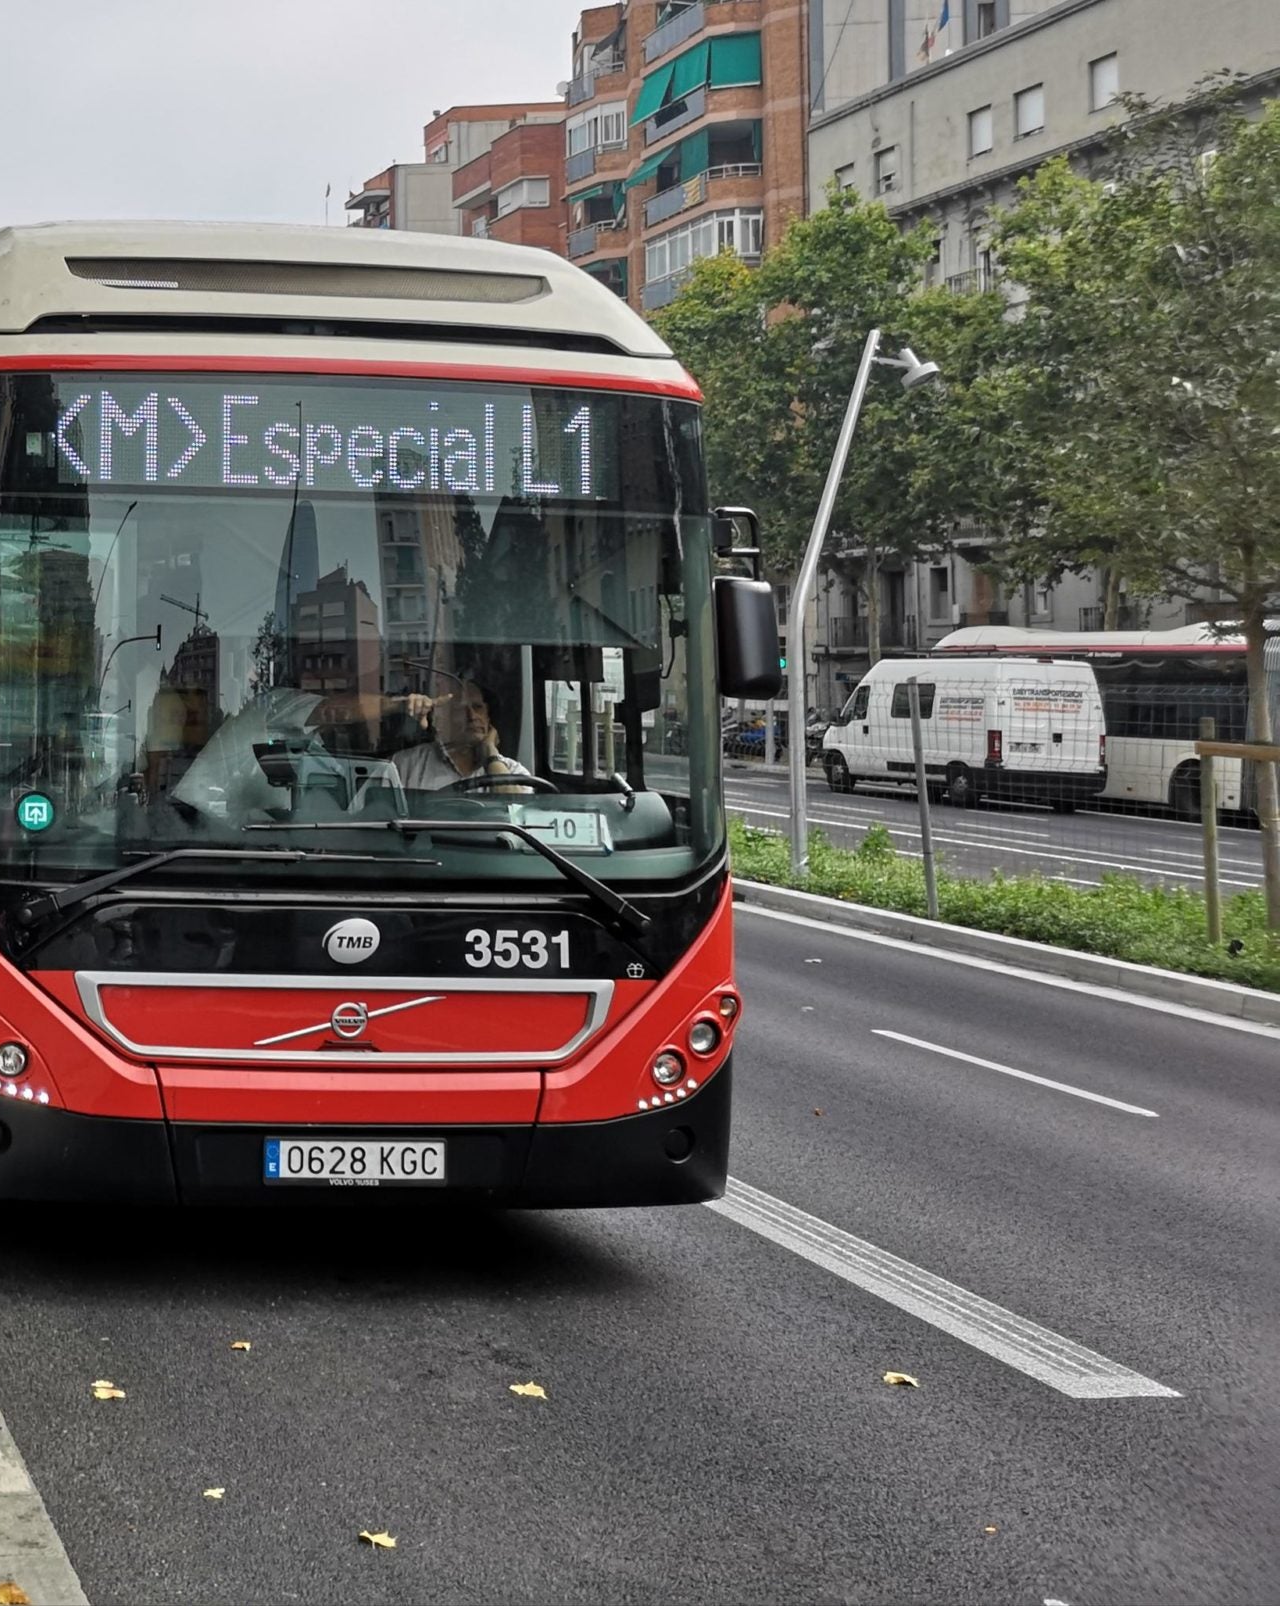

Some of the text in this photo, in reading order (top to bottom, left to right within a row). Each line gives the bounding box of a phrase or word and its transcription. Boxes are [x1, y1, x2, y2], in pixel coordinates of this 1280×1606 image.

[222, 395, 495, 492] Especial
[523, 404, 592, 495] L1
[550, 818, 577, 839] 10
[337, 936, 373, 949] TMB
[464, 928, 570, 969] 3531
[269, 1163, 277, 1172] E
[287, 1145, 438, 1176] 0628 KGC
[329, 1178, 354, 1186] VOLVO
